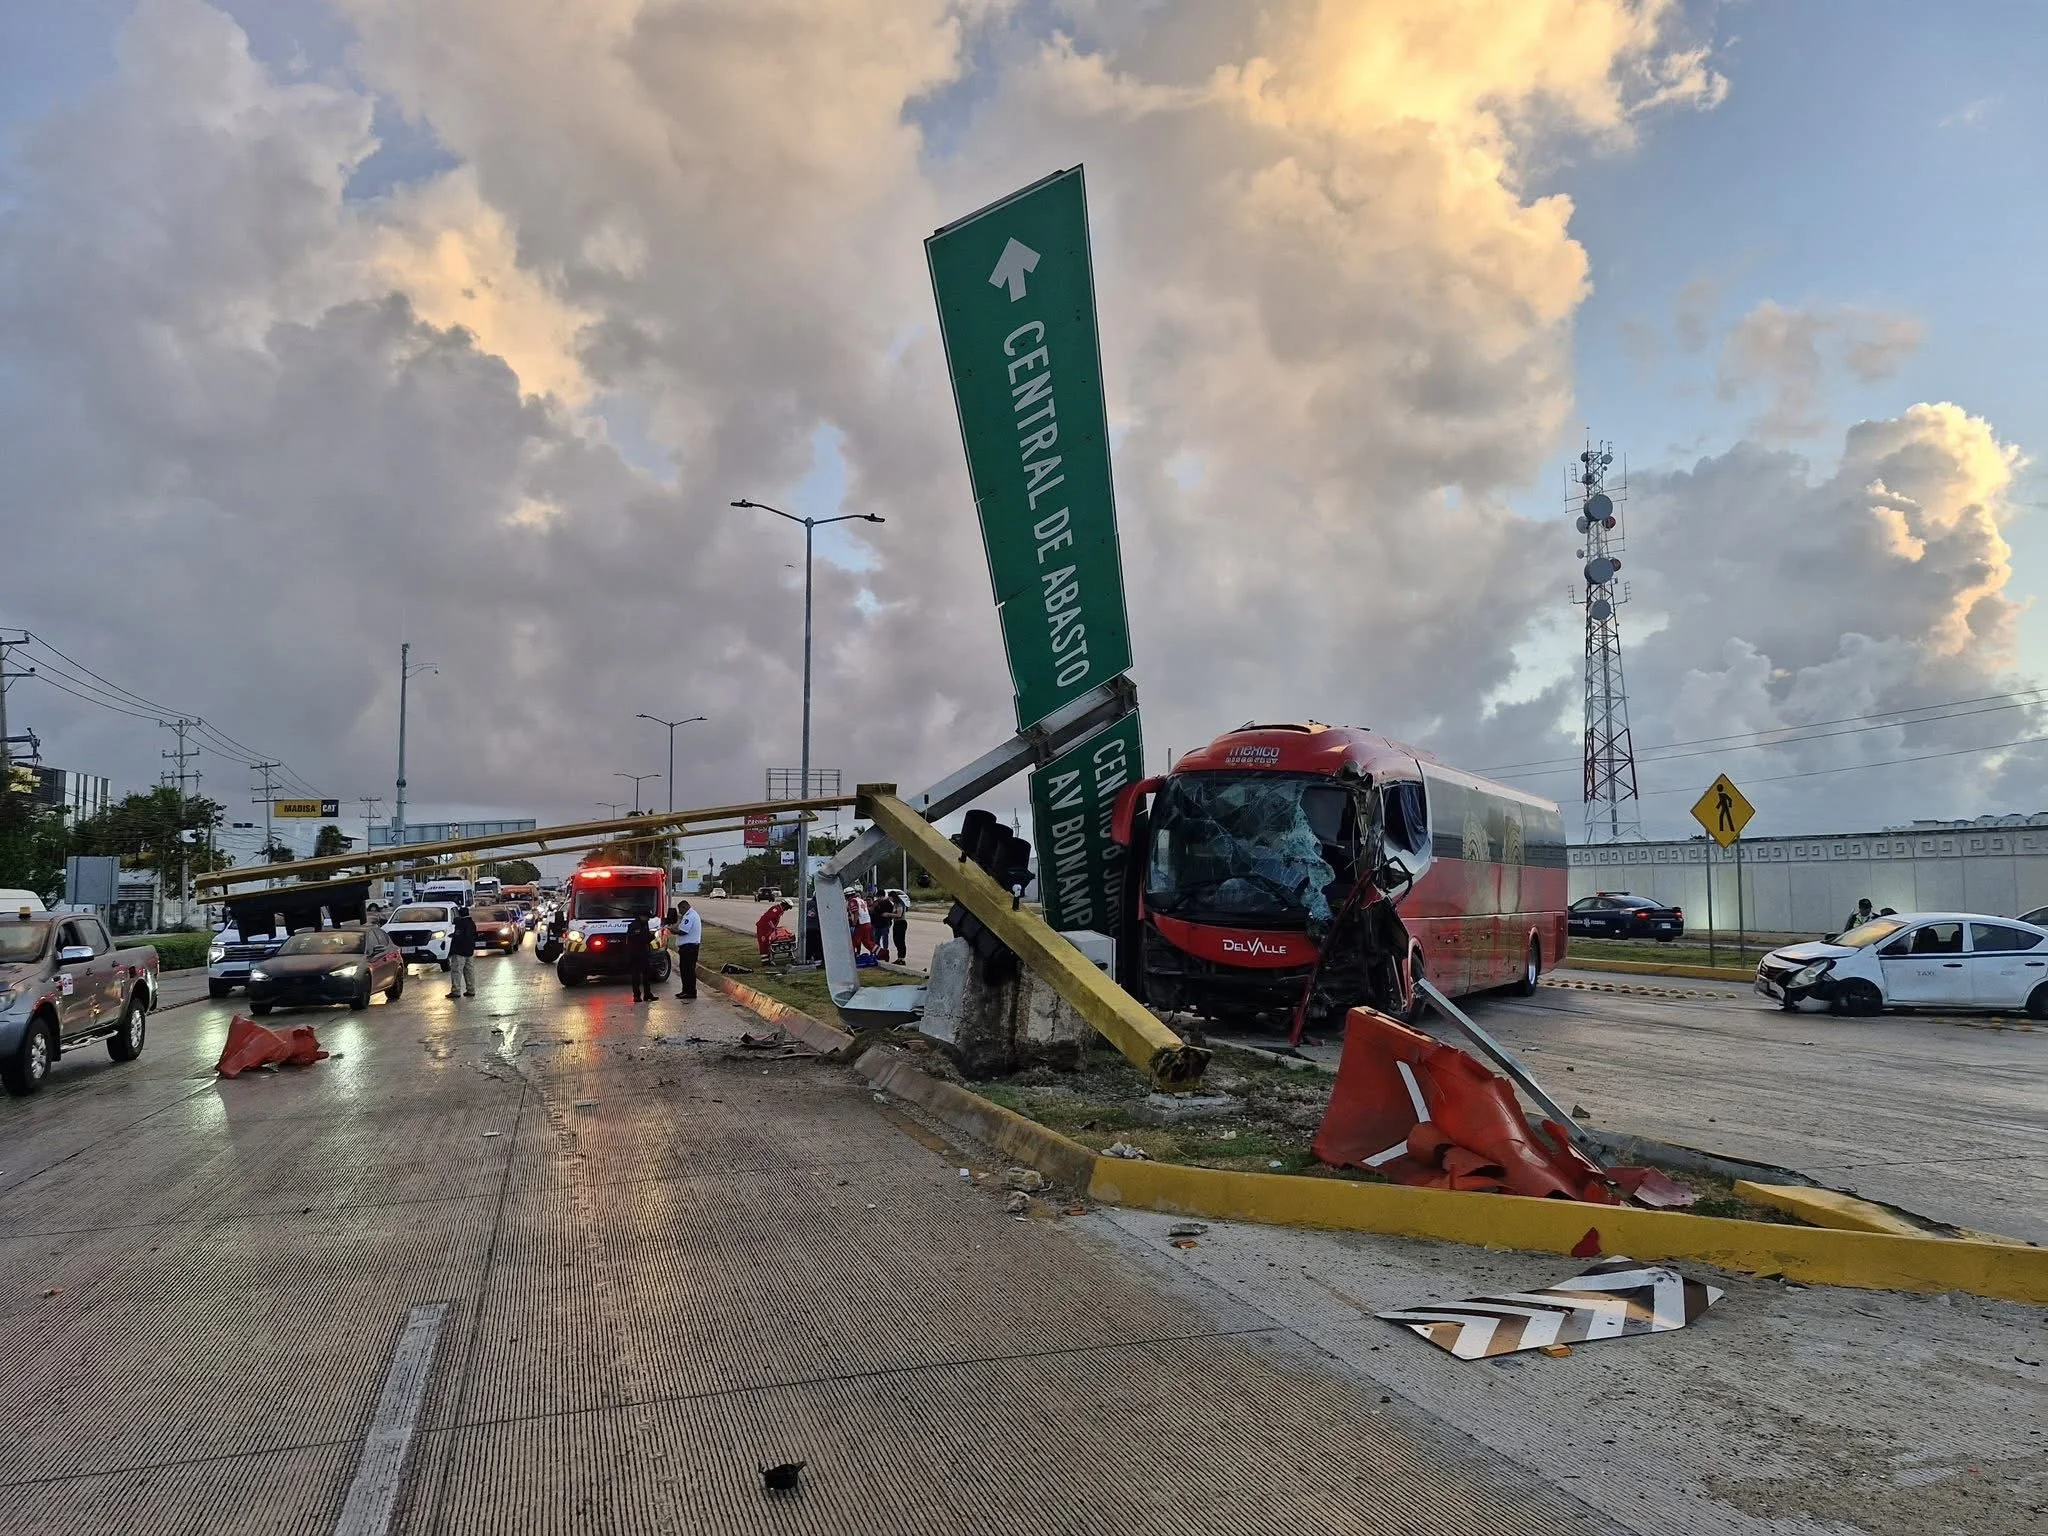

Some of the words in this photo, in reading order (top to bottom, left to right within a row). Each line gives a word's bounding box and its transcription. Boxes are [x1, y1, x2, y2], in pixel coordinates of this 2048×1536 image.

[1004, 320, 1065, 511] CENTRAL
[1033, 506, 1073, 565] DE
[1041, 564, 1090, 688] ABASTO
[283, 804, 316, 813] MADISA
[322, 804, 337, 813] CAT
[1048, 769, 1083, 811] AV
